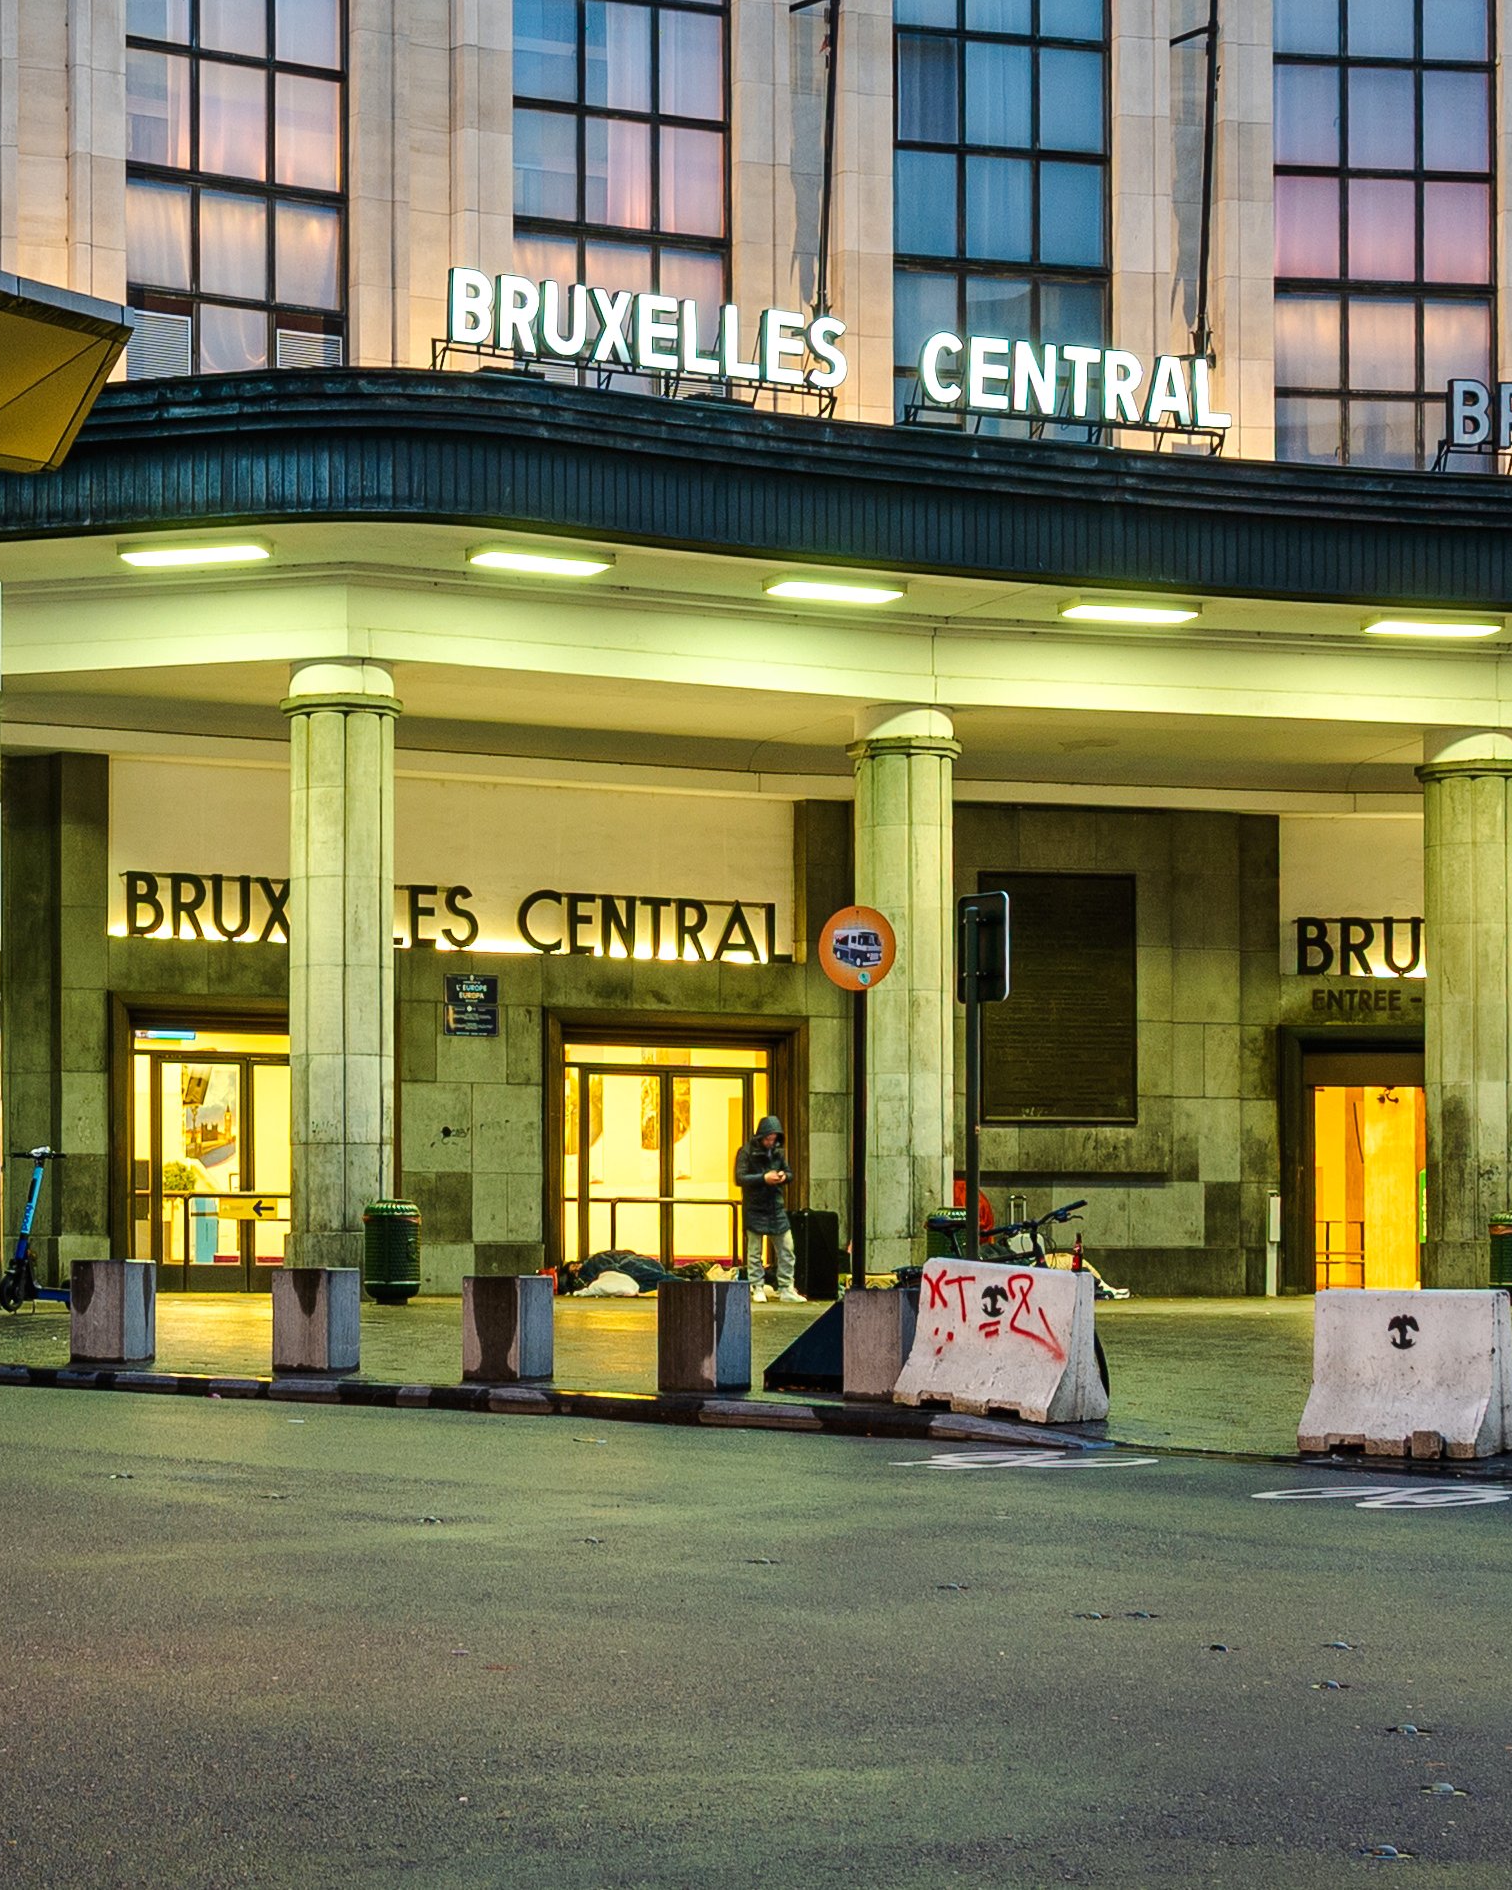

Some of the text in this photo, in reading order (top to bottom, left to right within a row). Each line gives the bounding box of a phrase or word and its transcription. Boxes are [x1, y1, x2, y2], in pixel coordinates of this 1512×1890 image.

[449, 267, 1232, 429] BRUXELLES CENTRAL
[126, 871, 793, 963] BRUXES CENTRAL
[1312, 989, 1402, 1010] ENTREE
